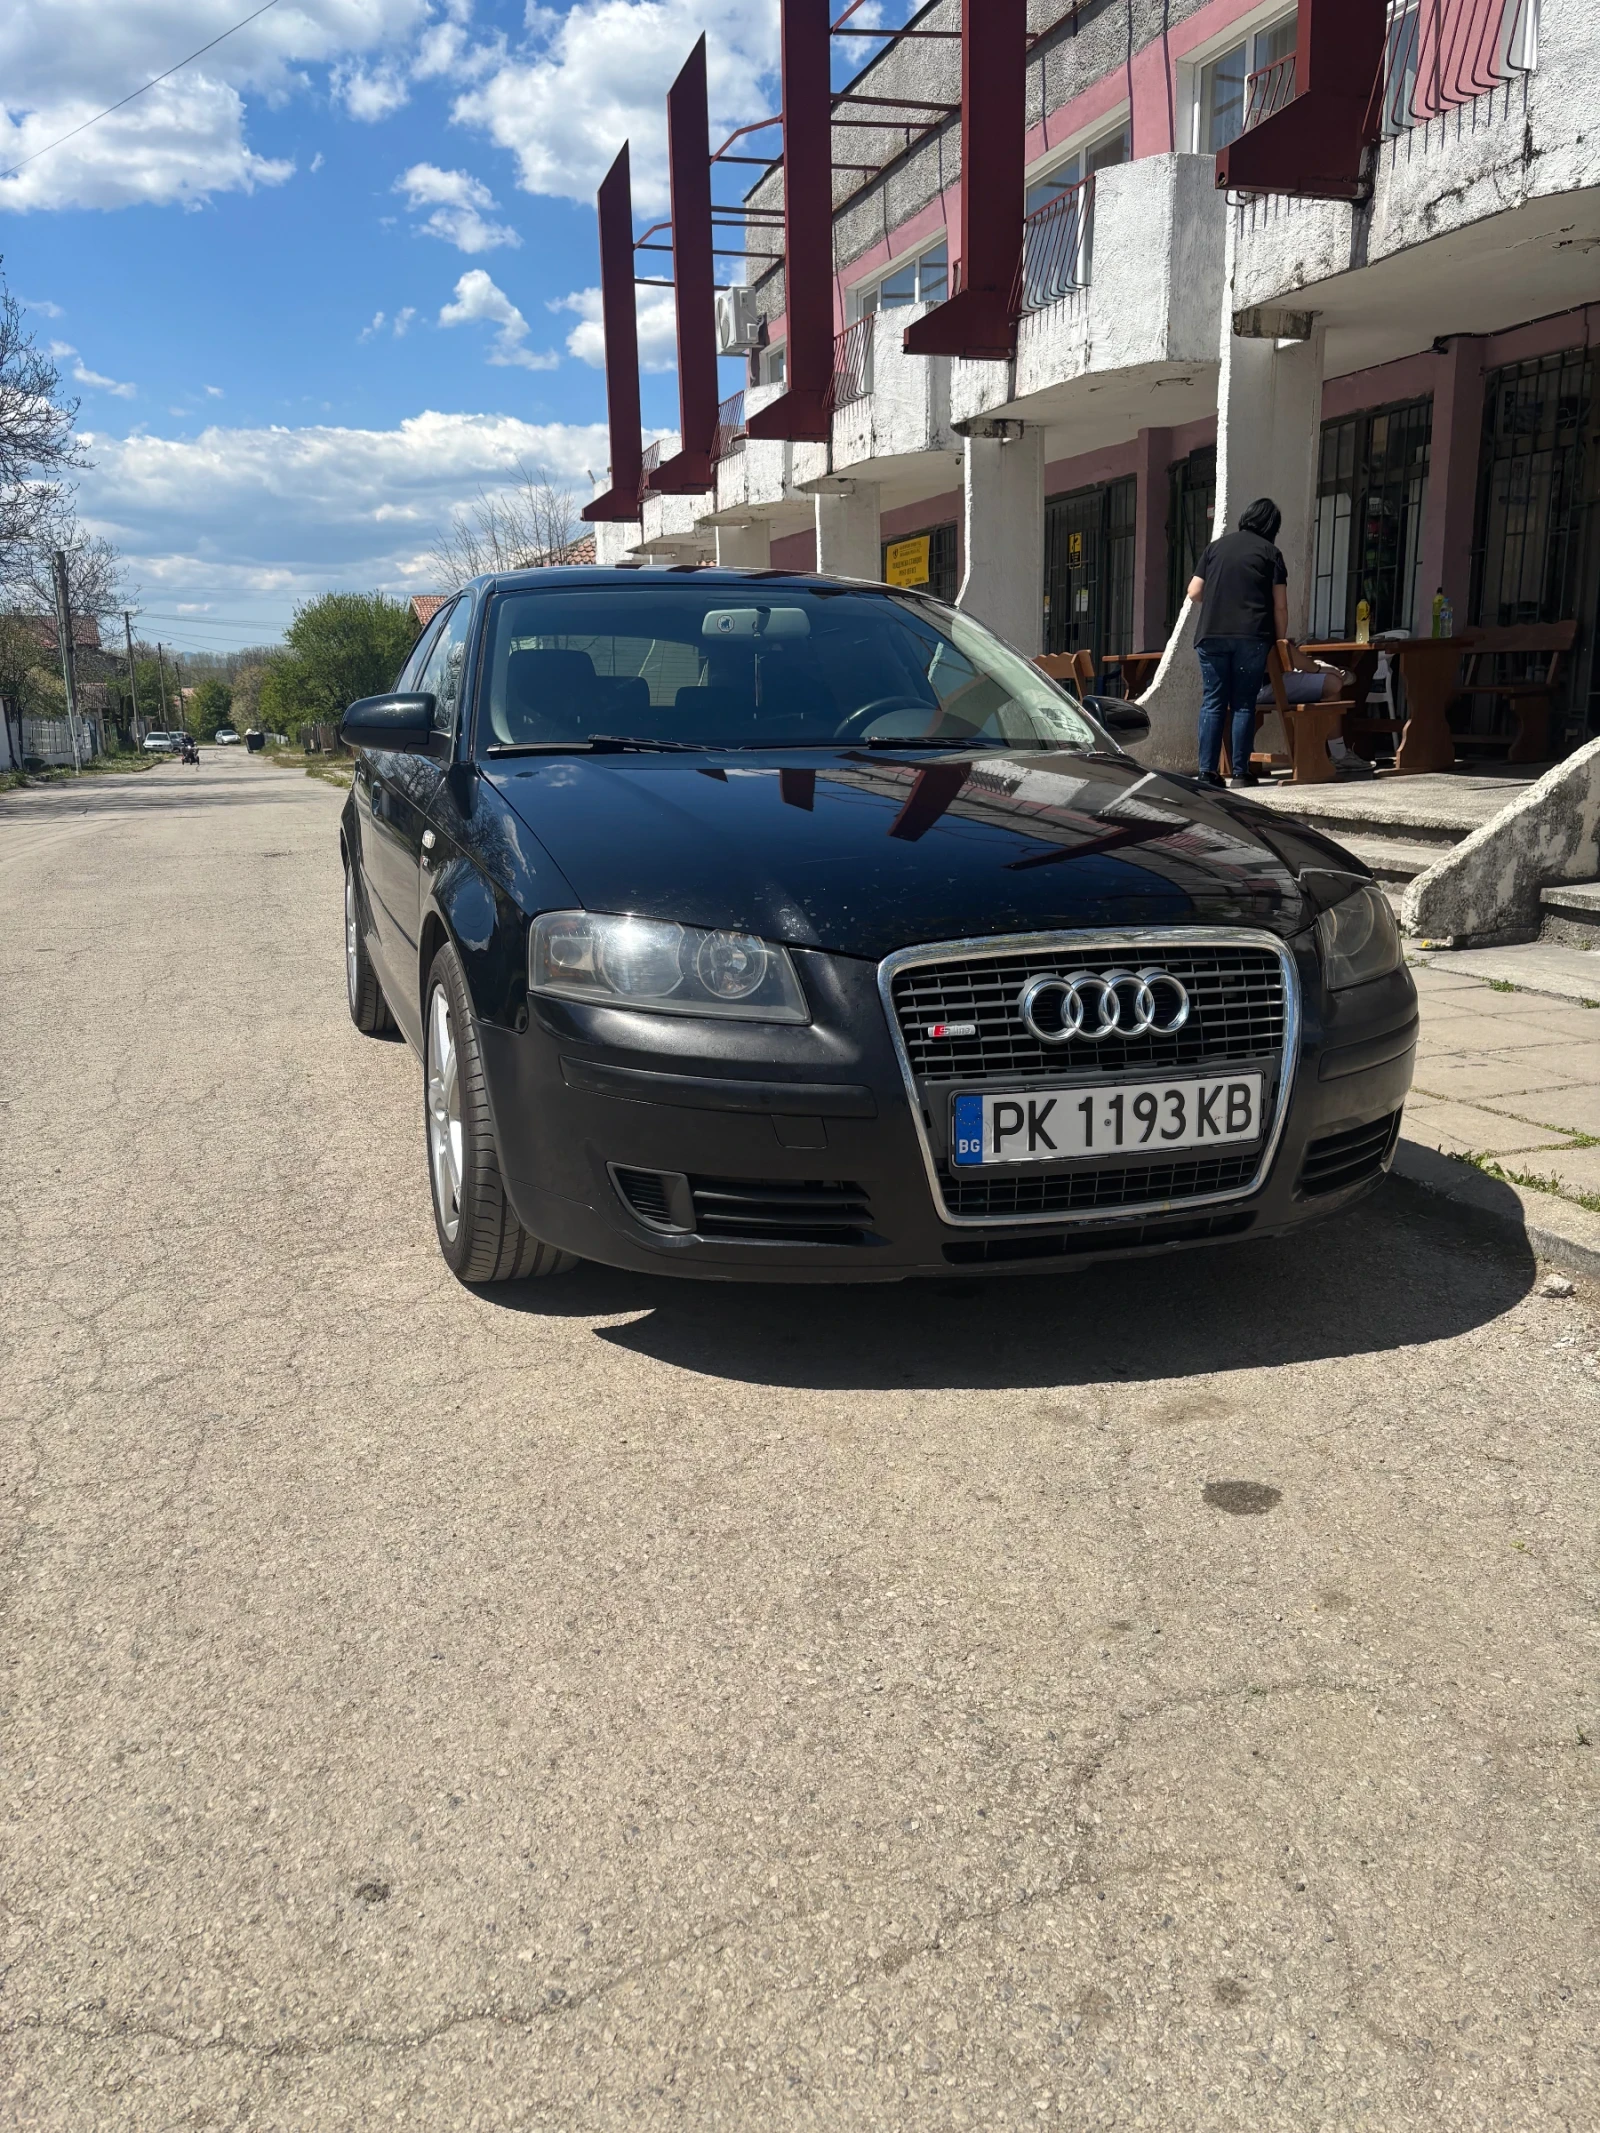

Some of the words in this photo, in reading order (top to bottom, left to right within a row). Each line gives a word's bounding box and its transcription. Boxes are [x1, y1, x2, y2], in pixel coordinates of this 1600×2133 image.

[993, 1099, 1057, 1153] PK
[1078, 1089, 1187, 1148] 1193
[1198, 1083, 1252, 1138] KB
[958, 1139, 980, 1154] BG
